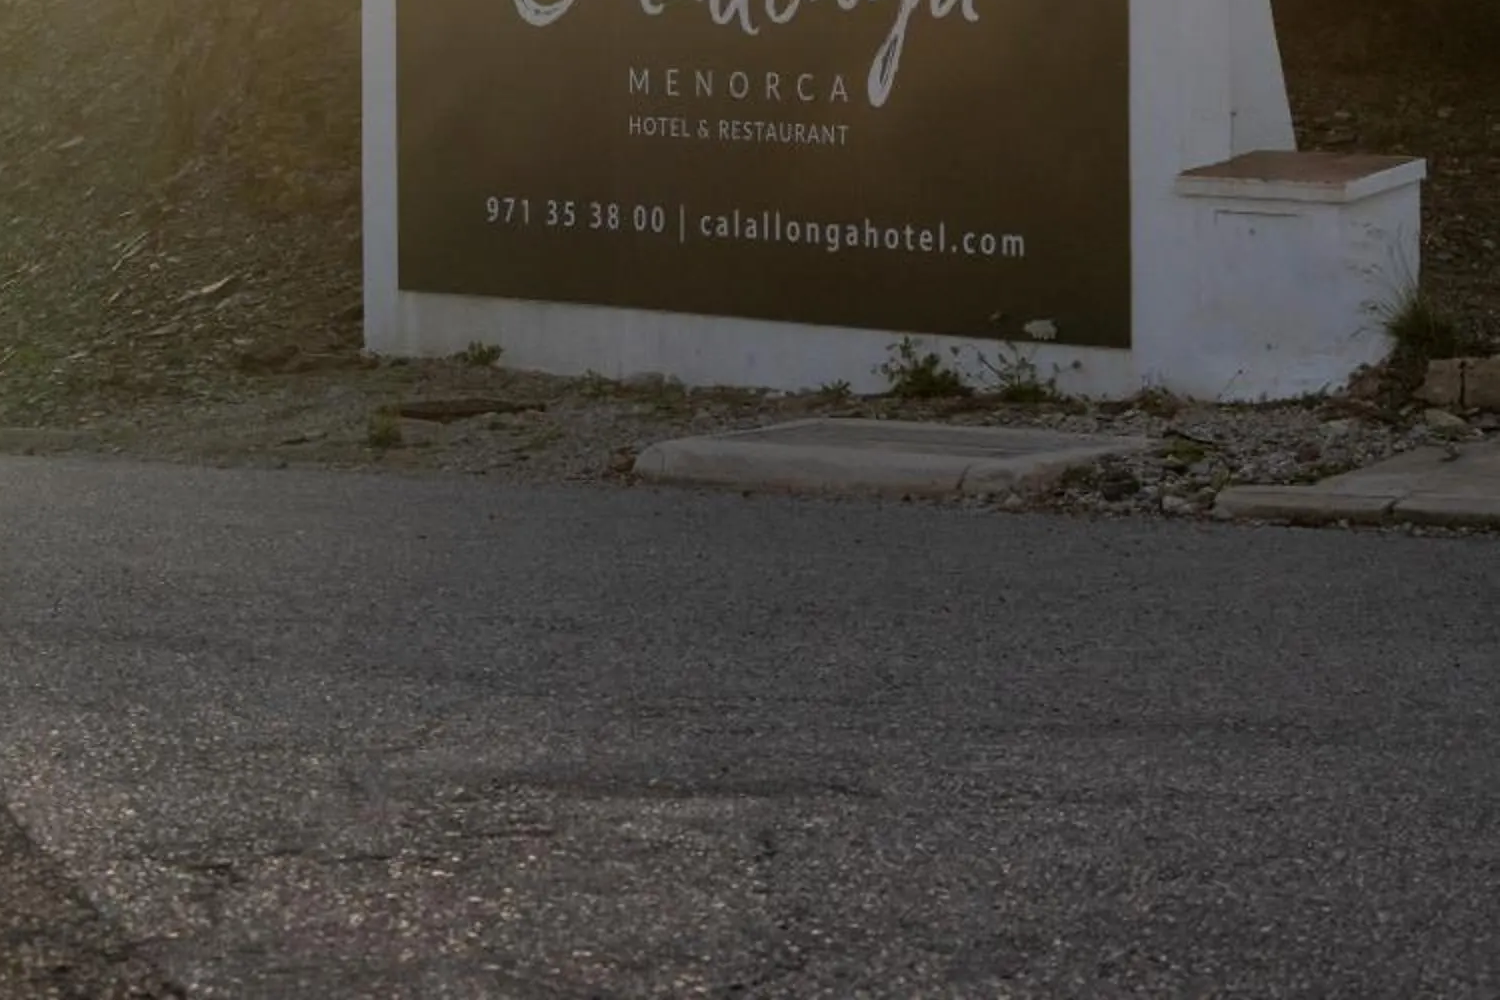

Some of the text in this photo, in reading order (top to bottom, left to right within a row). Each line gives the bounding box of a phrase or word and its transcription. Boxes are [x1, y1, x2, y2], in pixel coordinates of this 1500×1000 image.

[627, 67, 849, 103] MENORCA
[627, 115, 851, 146] HOTEL & RESTAURANT
[485, 195, 532, 224] 971
[546, 198, 577, 227] 35
[589, 201, 621, 230] 38
[632, 204, 666, 233] 00
[698, 208, 1027, 258] calallongahotel.com
